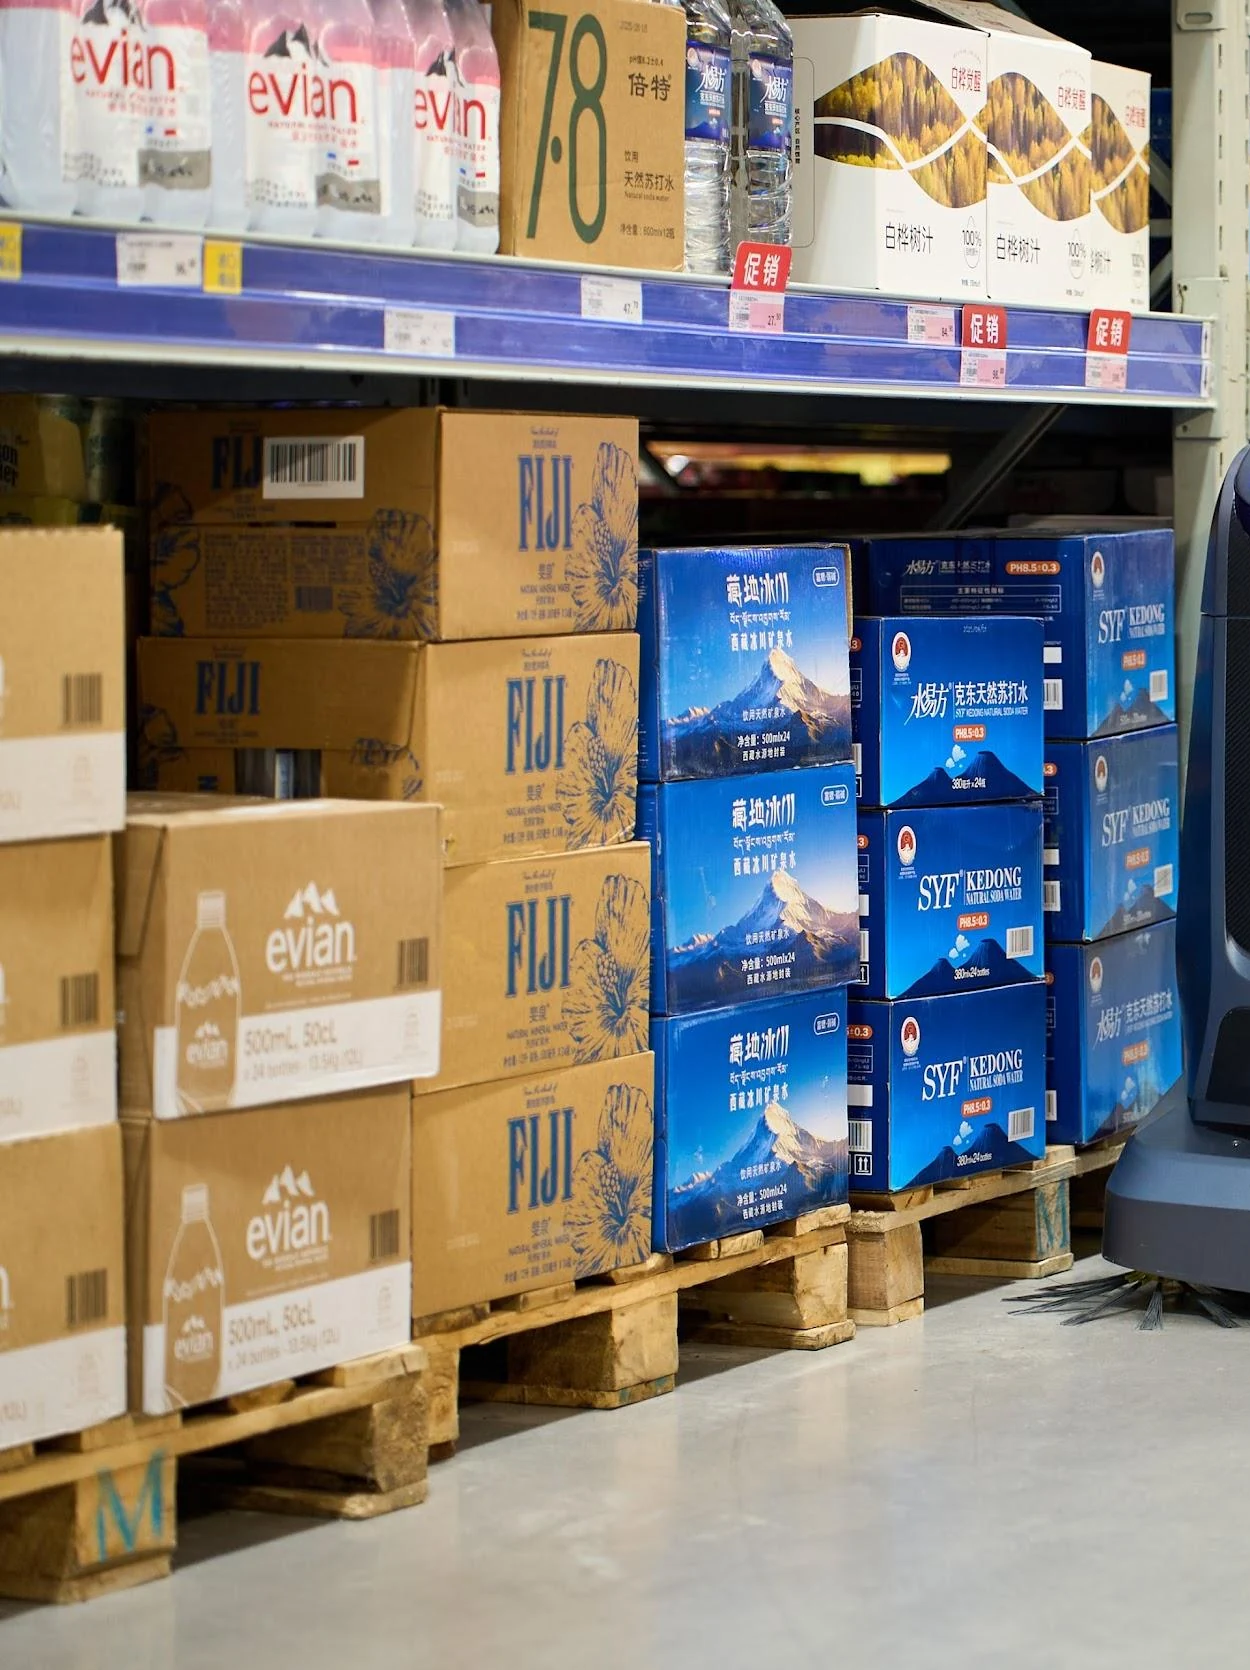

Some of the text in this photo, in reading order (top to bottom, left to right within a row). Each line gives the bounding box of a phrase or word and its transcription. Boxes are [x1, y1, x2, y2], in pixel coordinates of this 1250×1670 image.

[70, 28, 176, 91] evian
[248, 62, 357, 123] evian
[628, 72, 671, 101] 倍特
[951, 67, 982, 92] 白桦觉醒
[1057, 86, 1086, 111] 白桦觉醒
[624, 150, 639, 163] 饮用
[623, 171, 675, 191] 天然苏打水
[885, 221, 934, 254] 白桦树汁
[961, 229, 982, 248] 100%
[996, 233, 1041, 265] 白桦树汁
[1067, 242, 1087, 258] 100%
[743, 252, 780, 287] 促销
[970, 313, 999, 344] 促销
[1095, 318, 1124, 347] 促销
[211, 436, 263, 489] FIJ
[518, 455, 573, 552] FIJI
[1010, 563, 1056, 573] PH8.5±0.3
[726, 573, 789, 606] 藏地冰川
[1098, 609, 1125, 644] SYF
[1129, 604, 1165, 626] KEDONG
[731, 631, 793, 653] 西藏冰川矿泉水
[196, 661, 260, 716] FIJI
[955, 681, 1028, 705] 克东天然苏打水
[505, 675, 566, 775] FIJI
[743, 707, 786, 723] 饮用天然矿泉水
[966, 708, 983, 717] KEDONG
[983, 707, 1003, 716] NATURAL
[743, 747, 786, 763] 西藏水源地封装
[732, 793, 795, 831] 藏地冰川
[1101, 809, 1129, 847] SYF
[1132, 798, 1170, 824] KEDONG
[732, 850, 797, 877] 西藏冰川矿泉水
[917, 866, 1022, 911] SYF KEDONG
[966, 887, 1022, 906] NATURAL SODA WATER
[265, 917, 356, 974] evian
[505, 894, 572, 998] FIJI
[745, 928, 790, 945] 饮用天然矿泉水
[746, 967, 791, 985] 西藏水源地封装
[730, 1025, 789, 1067] 藏地冰川
[922, 1049, 1023, 1101] SYF KEDONG
[969, 1071, 1024, 1092] NATURAL SODA WATER
[730, 1083, 789, 1112] 西藏冰川矿泉水
[507, 1107, 575, 1214] FIJI
[740, 1161, 781, 1180] 饮用天然矿泉水
[742, 1201, 783, 1220] 西藏水源地封装
[246, 1201, 330, 1260] evian
[97, 1448, 168, 1563] M
